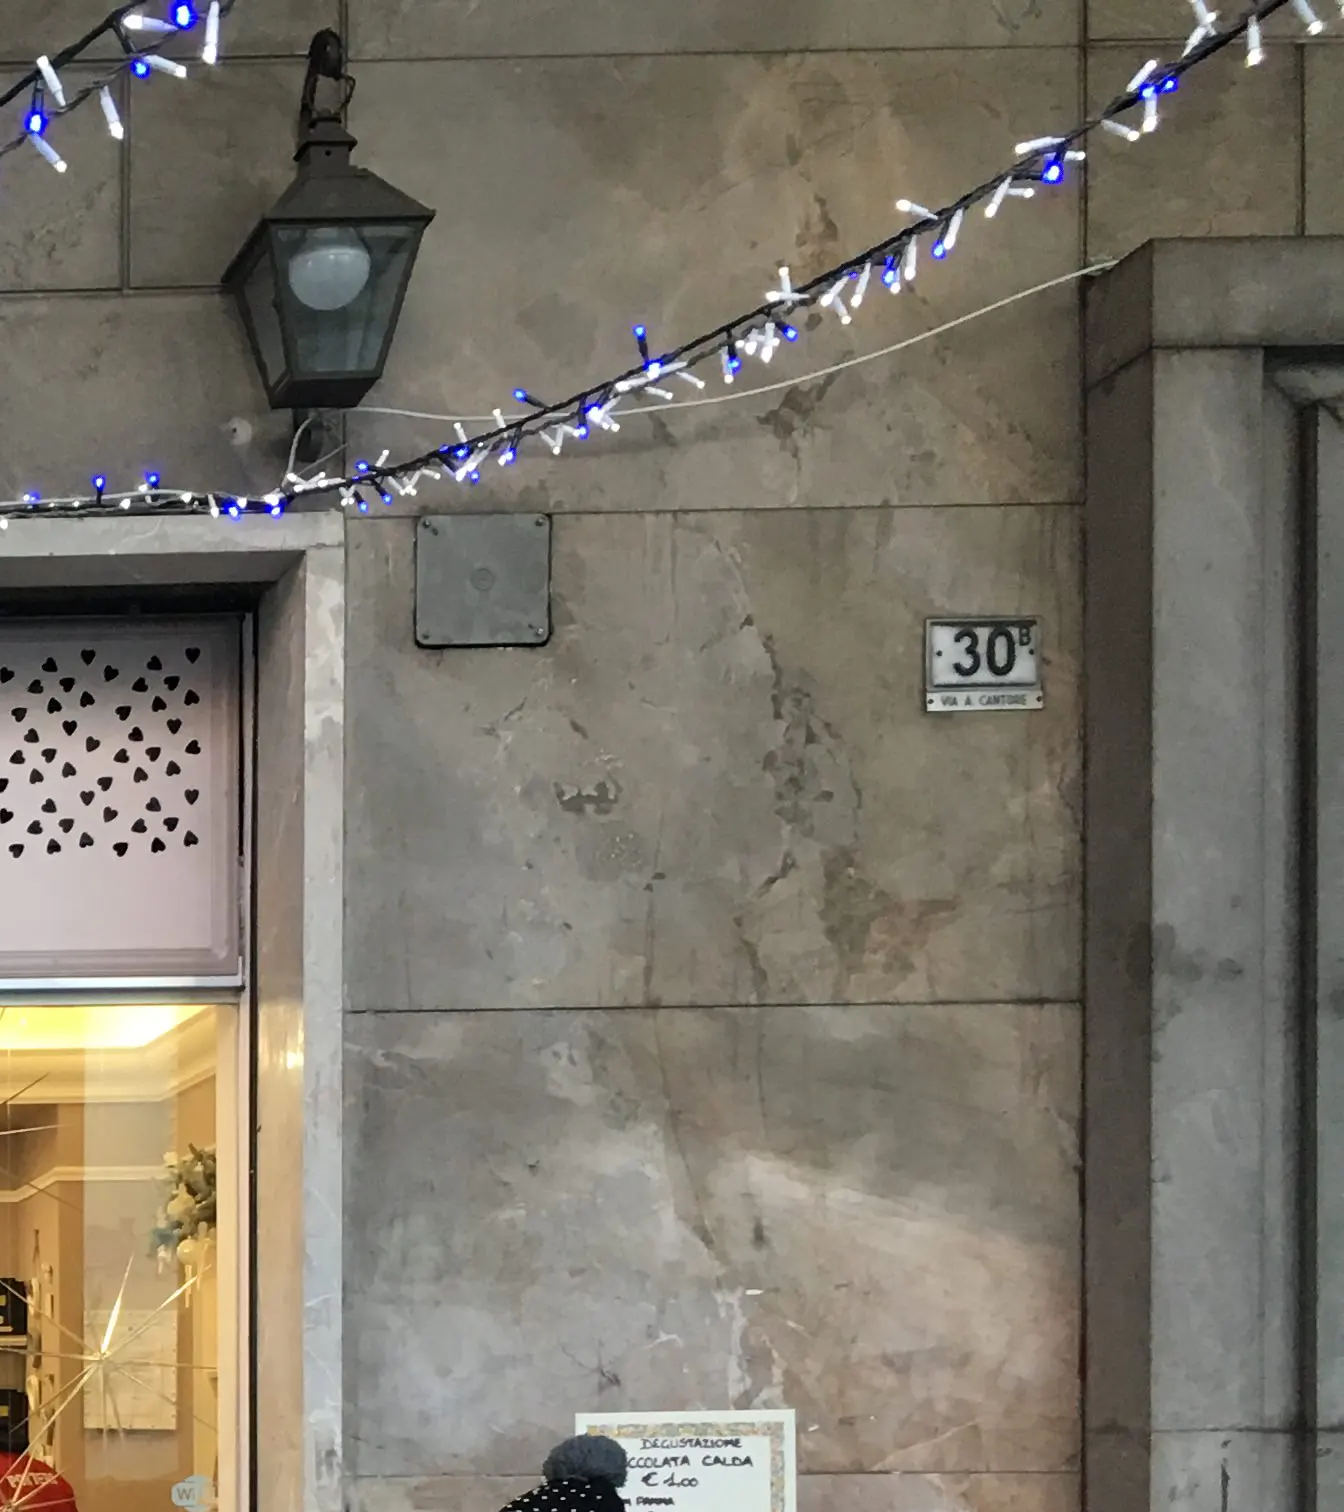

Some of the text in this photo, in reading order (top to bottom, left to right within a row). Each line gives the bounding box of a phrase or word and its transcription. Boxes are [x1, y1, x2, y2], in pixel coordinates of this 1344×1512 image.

[640, 1438, 742, 1450] DEGUSTAZIONE
[626, 1454, 754, 1469] CCOLATA CALDA
[641, 1471, 658, 1487] €
